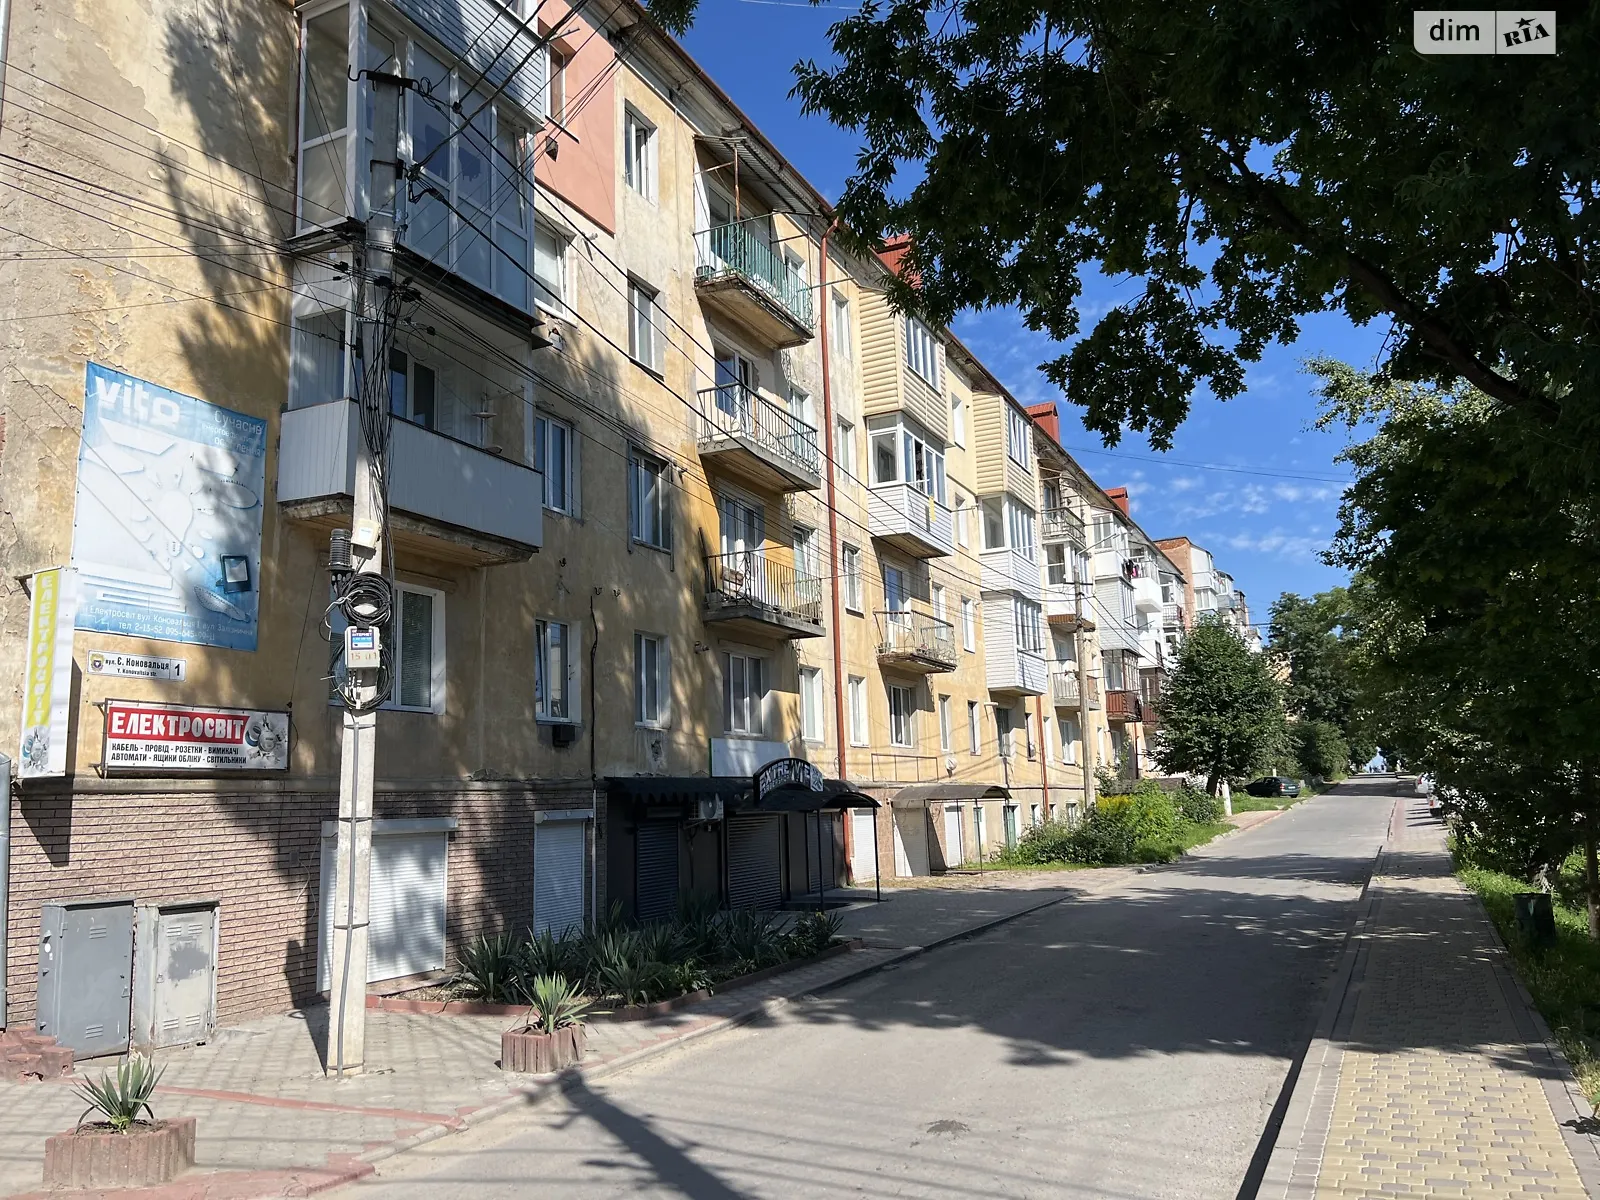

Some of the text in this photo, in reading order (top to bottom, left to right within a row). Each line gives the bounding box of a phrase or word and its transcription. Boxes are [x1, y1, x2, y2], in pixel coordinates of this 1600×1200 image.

[214, 410, 262, 435] Сучасне
[126, 657, 170, 670] Коновальця
[174, 663, 181, 676] 1
[111, 712, 244, 740] ЕЛЕКТРОСВІТ
[111, 743, 239, 755] КАБЕЛЬ ПРОВІД РОЗЕТКИ ВИМИКАЧІ
[111, 753, 247, 765] АВТОМАТИ ЯЩИКИ ОБЛІКУ СВІТИЛЬНИКИ
